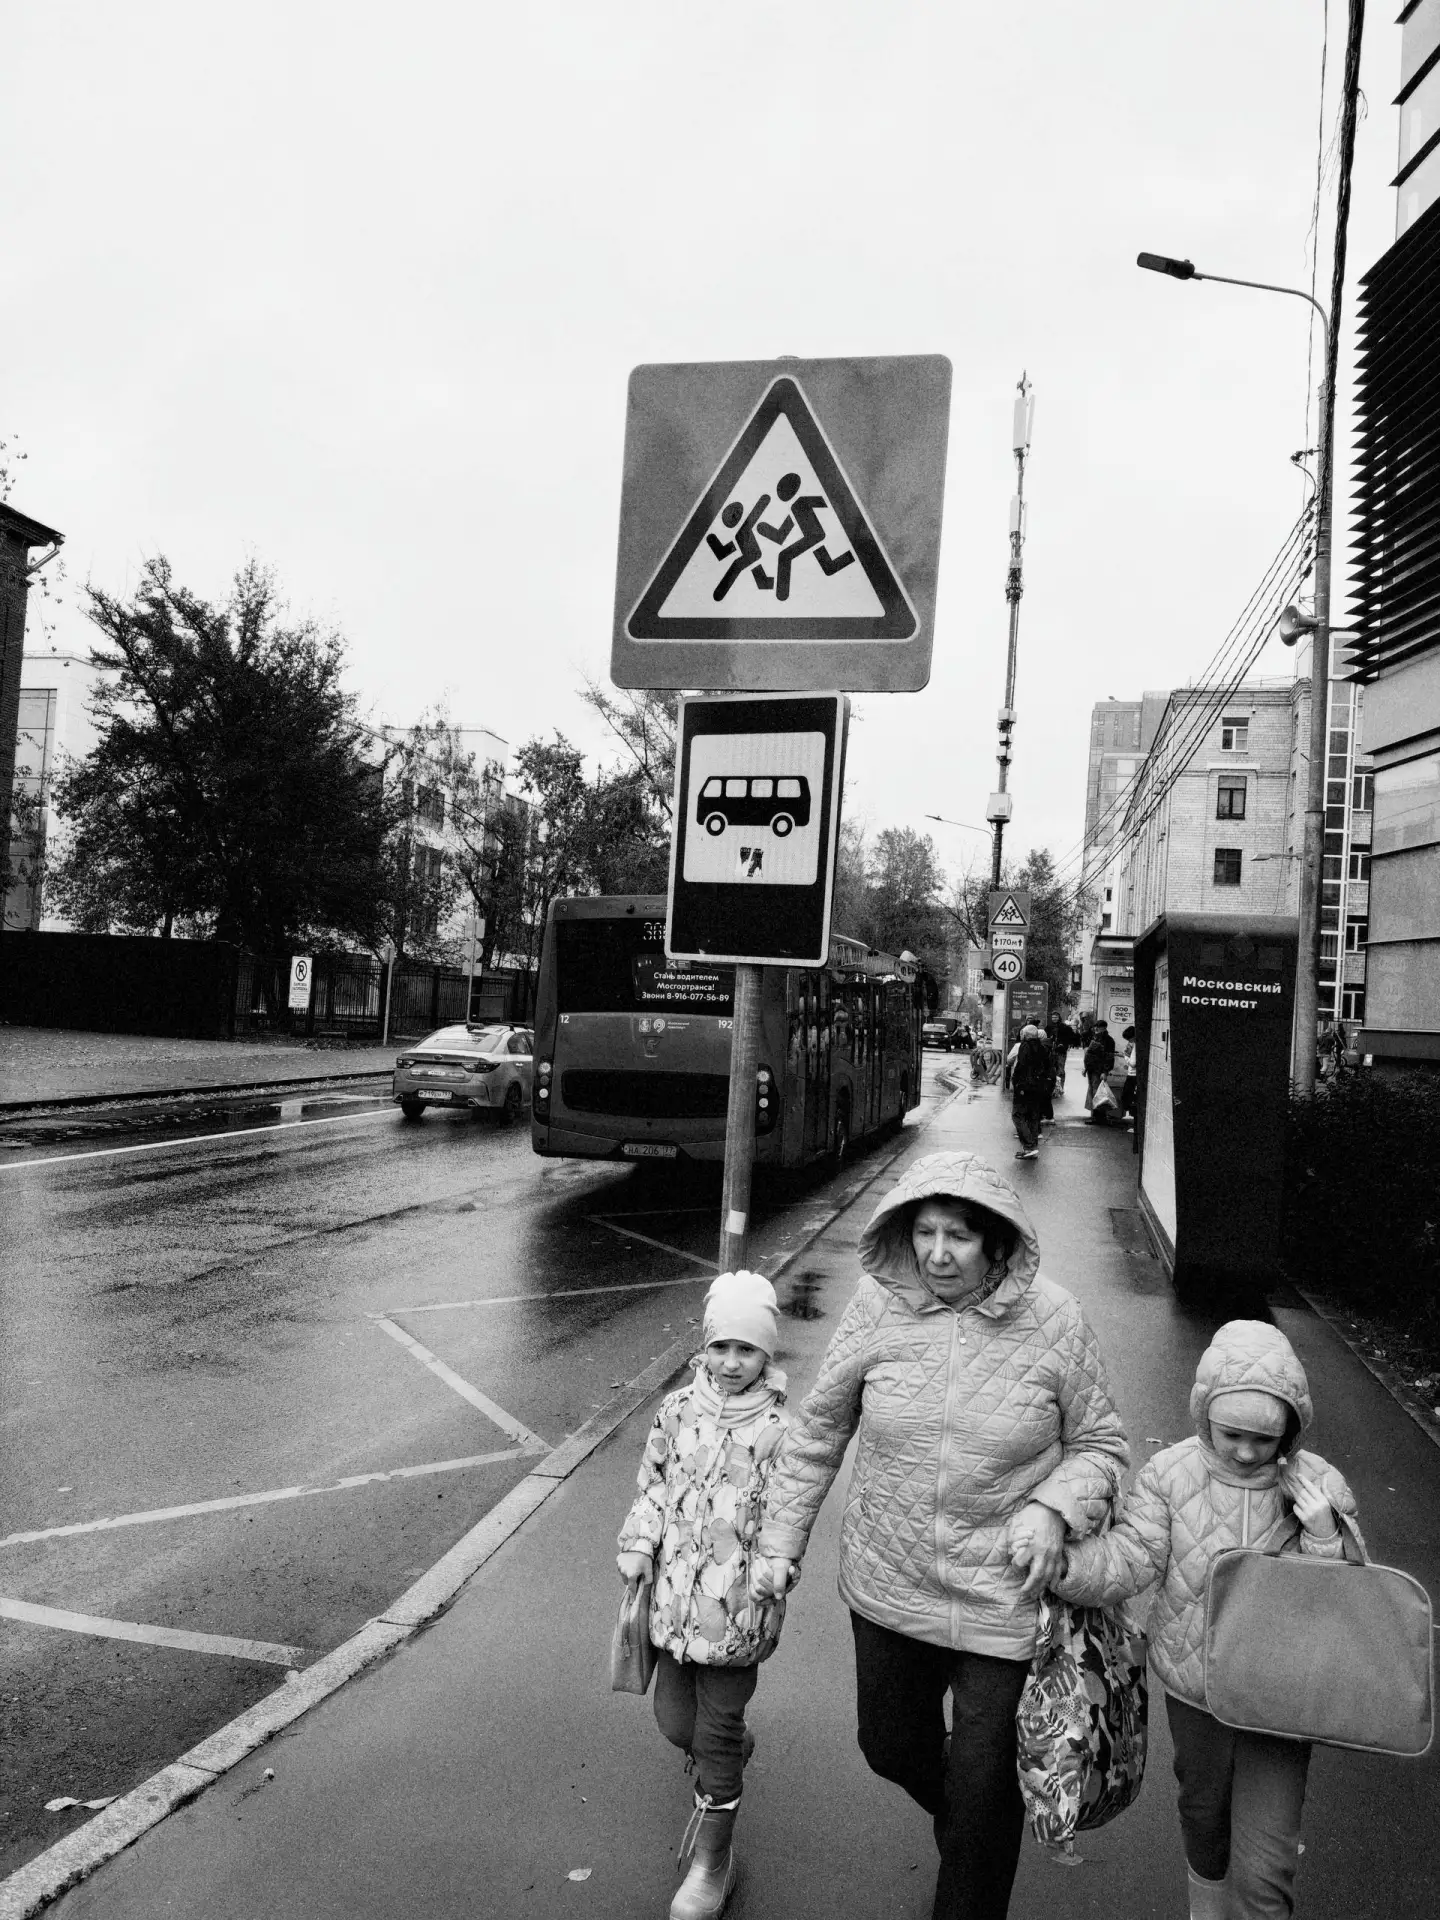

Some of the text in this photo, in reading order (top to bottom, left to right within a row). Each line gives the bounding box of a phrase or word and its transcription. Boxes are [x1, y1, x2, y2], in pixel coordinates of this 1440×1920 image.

[998, 961, 1016, 973] 40
[653, 972, 719, 981] Стань водителем
[656, 982, 715, 991] Мосгортранса!
[1183, 976, 1282, 994] Московский
[641, 991, 730, 1002] Звони 8-916-077-56-89
[1181, 995, 1258, 1009] постамат
[560, 1014, 570, 1024] 12
[718, 1019, 733, 1029] 192
[643, 1145, 659, 1156] 206
